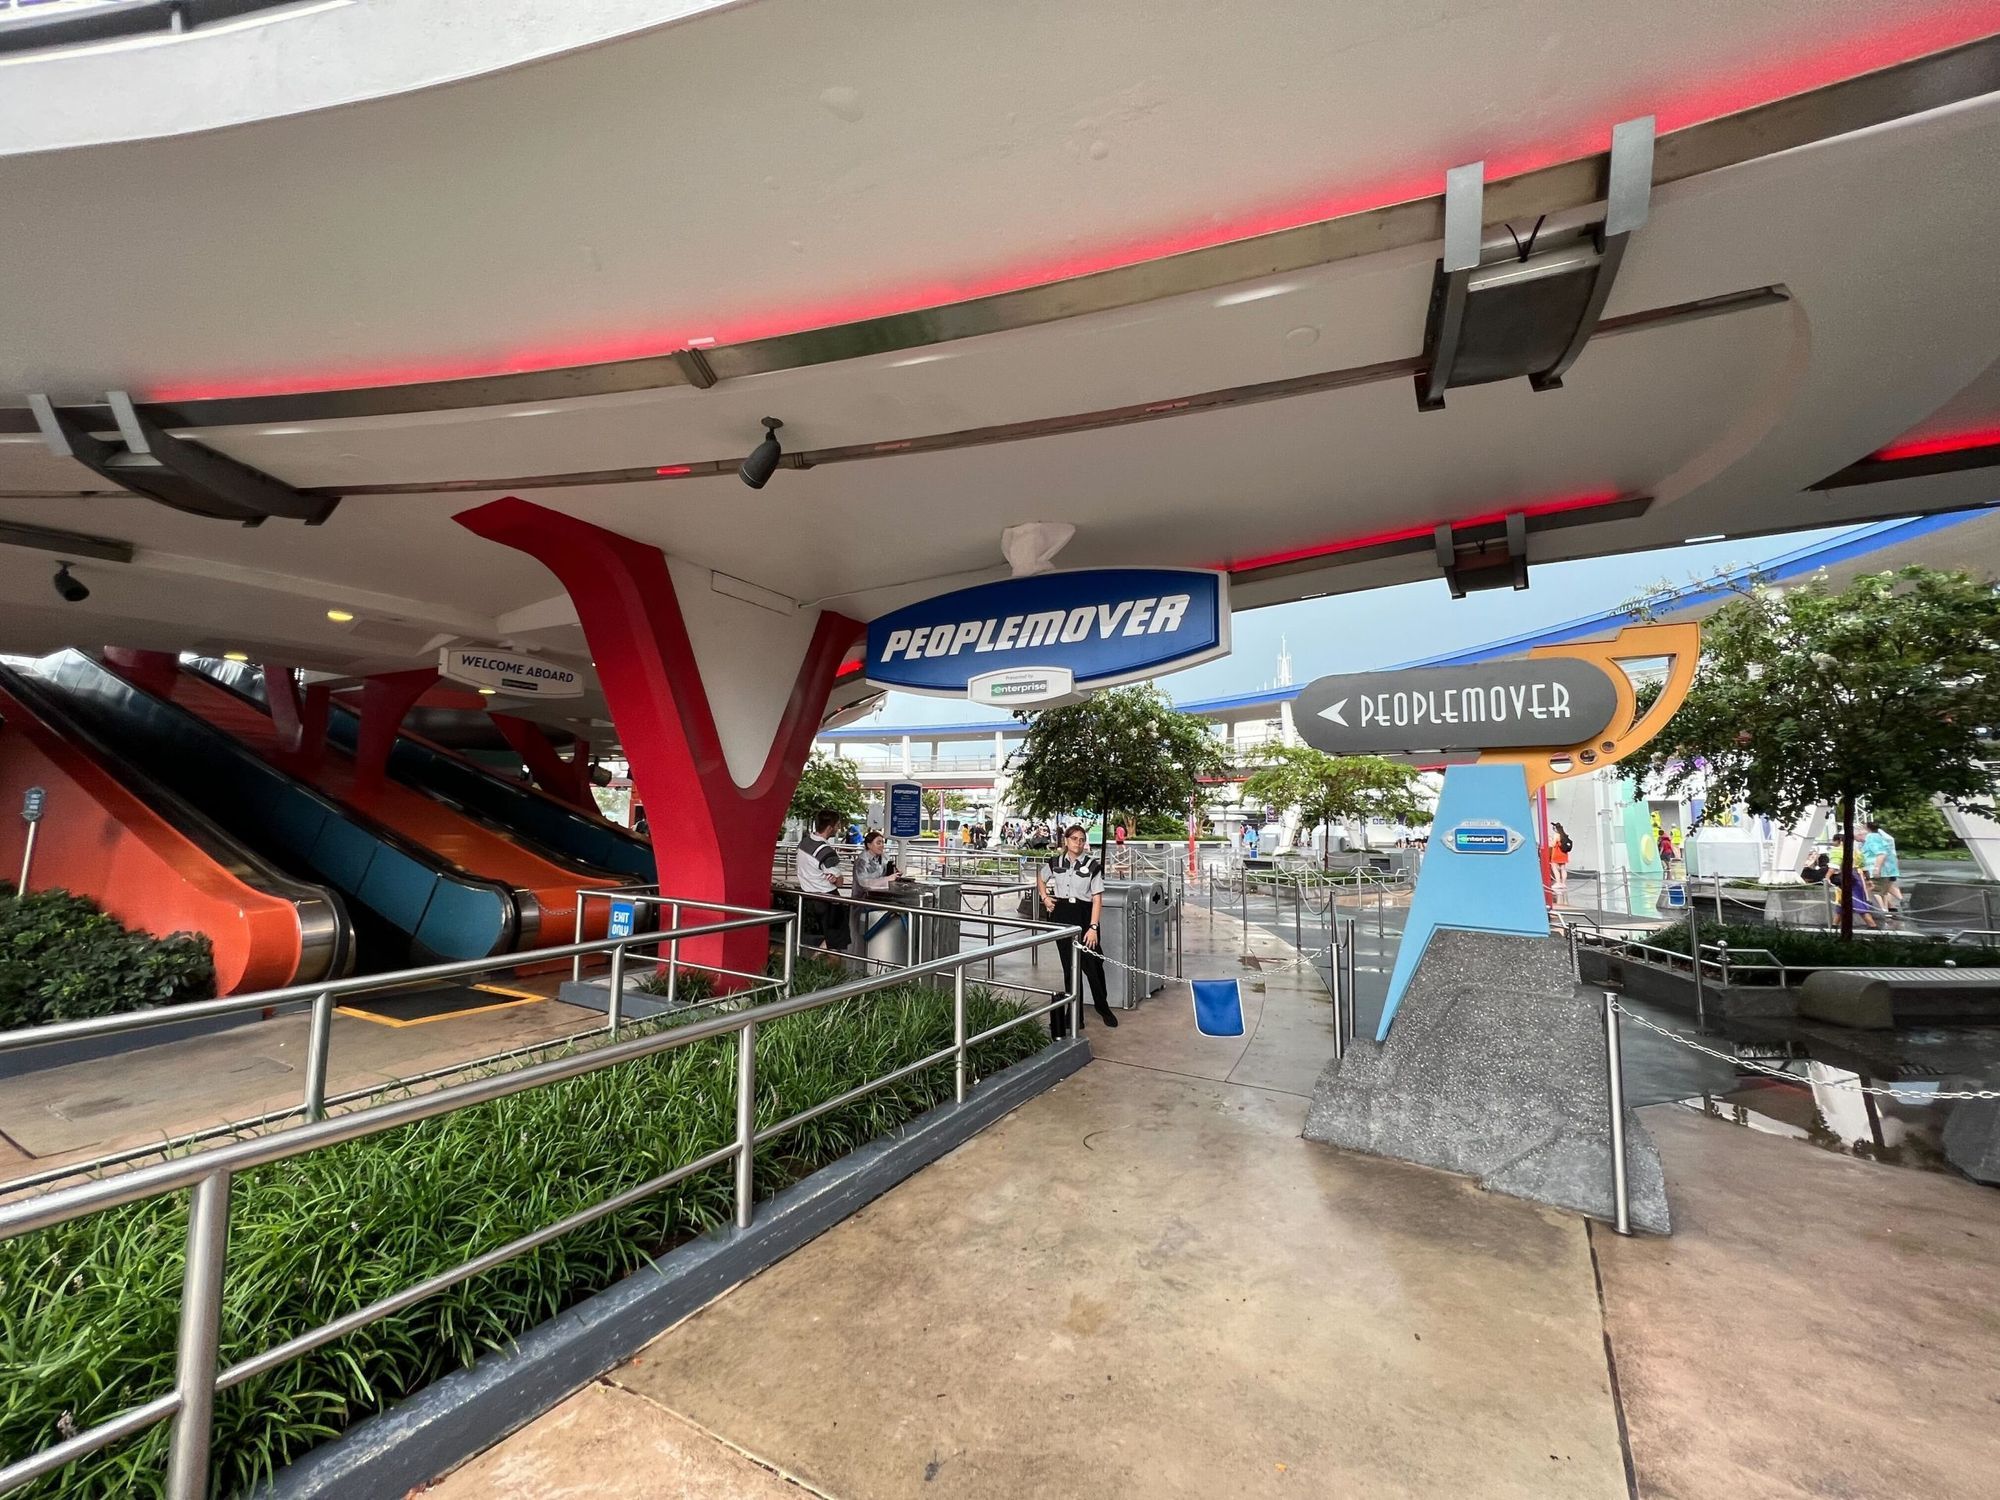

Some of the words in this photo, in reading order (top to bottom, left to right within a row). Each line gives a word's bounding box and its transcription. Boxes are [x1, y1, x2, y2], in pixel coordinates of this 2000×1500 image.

[880, 594, 1191, 663] PEOPLEMOVER
[461, 654, 524, 675] WELCOME
[526, 666, 574, 683] ABOARD
[993, 682, 1046, 694] enterprise
[1360, 682, 1570, 728] PEOPLEMOVER
[613, 911, 630, 923] EXIT
[611, 924, 629, 937] ONLY
